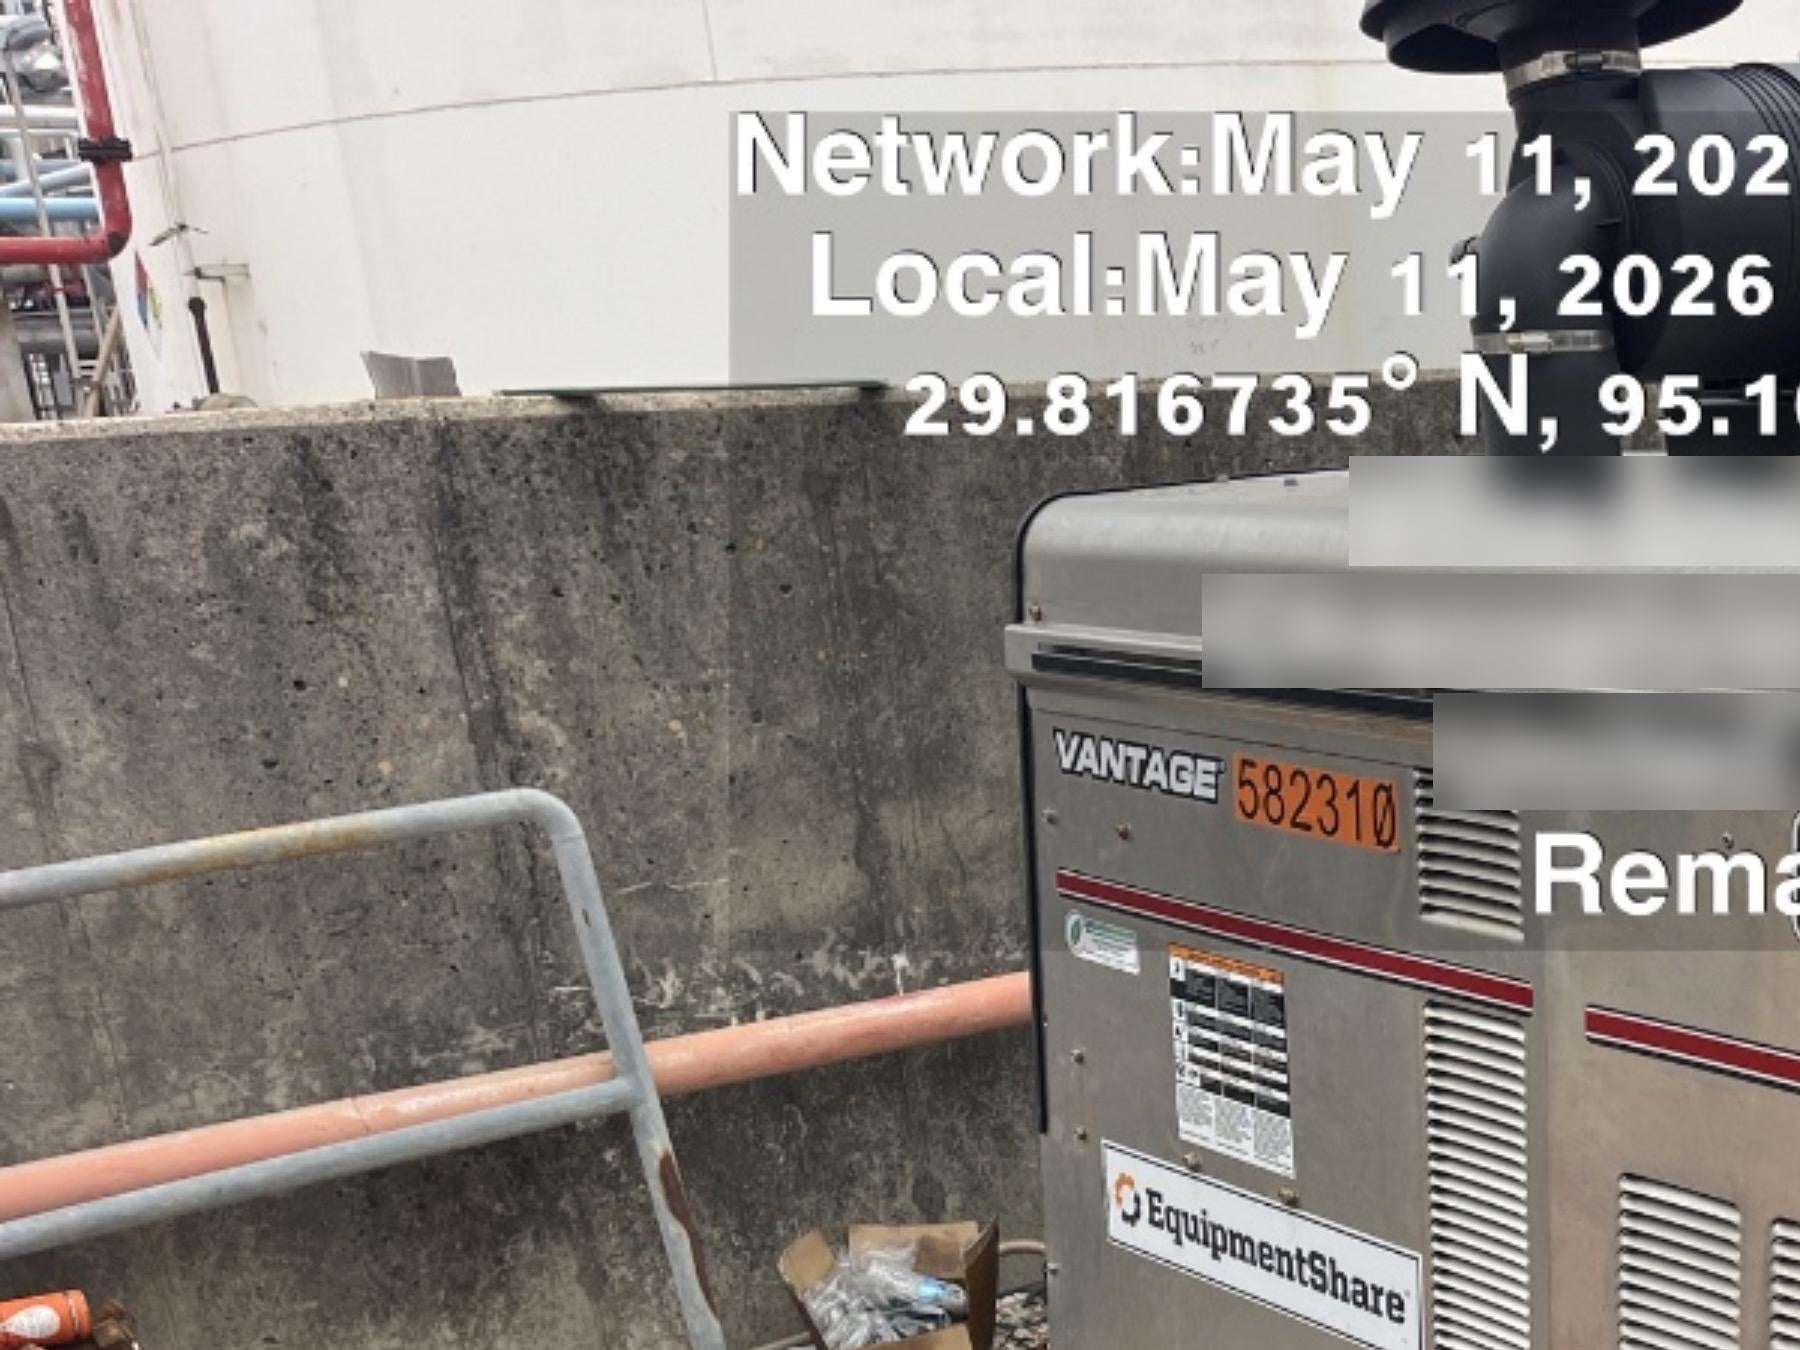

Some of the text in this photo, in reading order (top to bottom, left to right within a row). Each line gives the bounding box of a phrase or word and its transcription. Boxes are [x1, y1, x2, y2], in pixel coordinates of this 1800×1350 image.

[1053, 727, 1220, 804] VANTAGE
[1238, 758, 1397, 848] 582310
[1145, 1187, 1405, 1324] EquipmentShare
